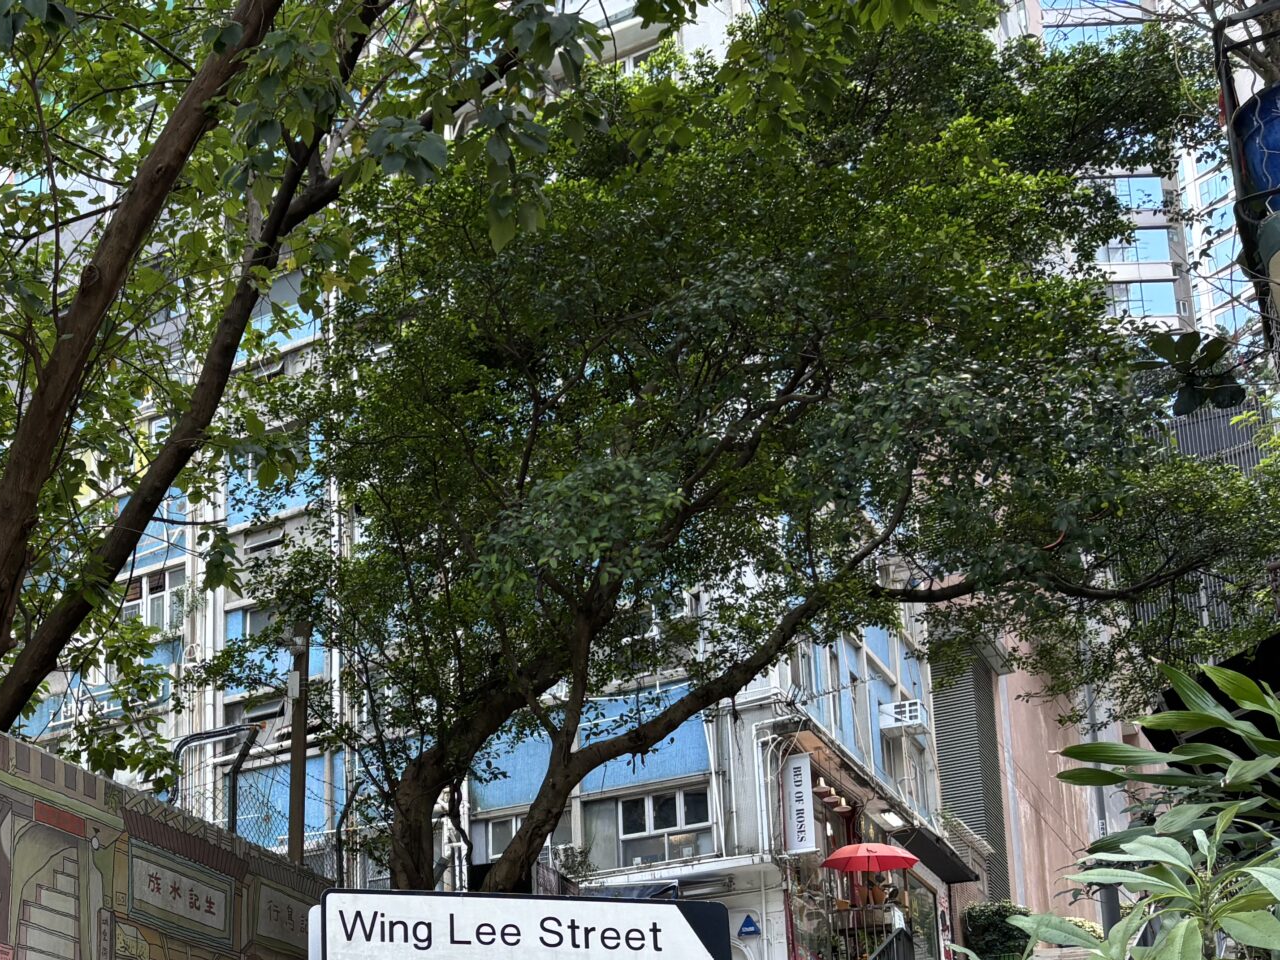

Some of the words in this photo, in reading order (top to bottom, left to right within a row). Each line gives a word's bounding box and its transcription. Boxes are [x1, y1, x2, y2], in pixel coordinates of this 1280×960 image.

[792, 766, 803, 788] BED
[794, 791, 805, 804] OF
[795, 808, 807, 843] ROSES
[339, 910, 433, 951] Wing
[448, 913, 521, 947] Lee
[539, 916, 663, 953] Street
